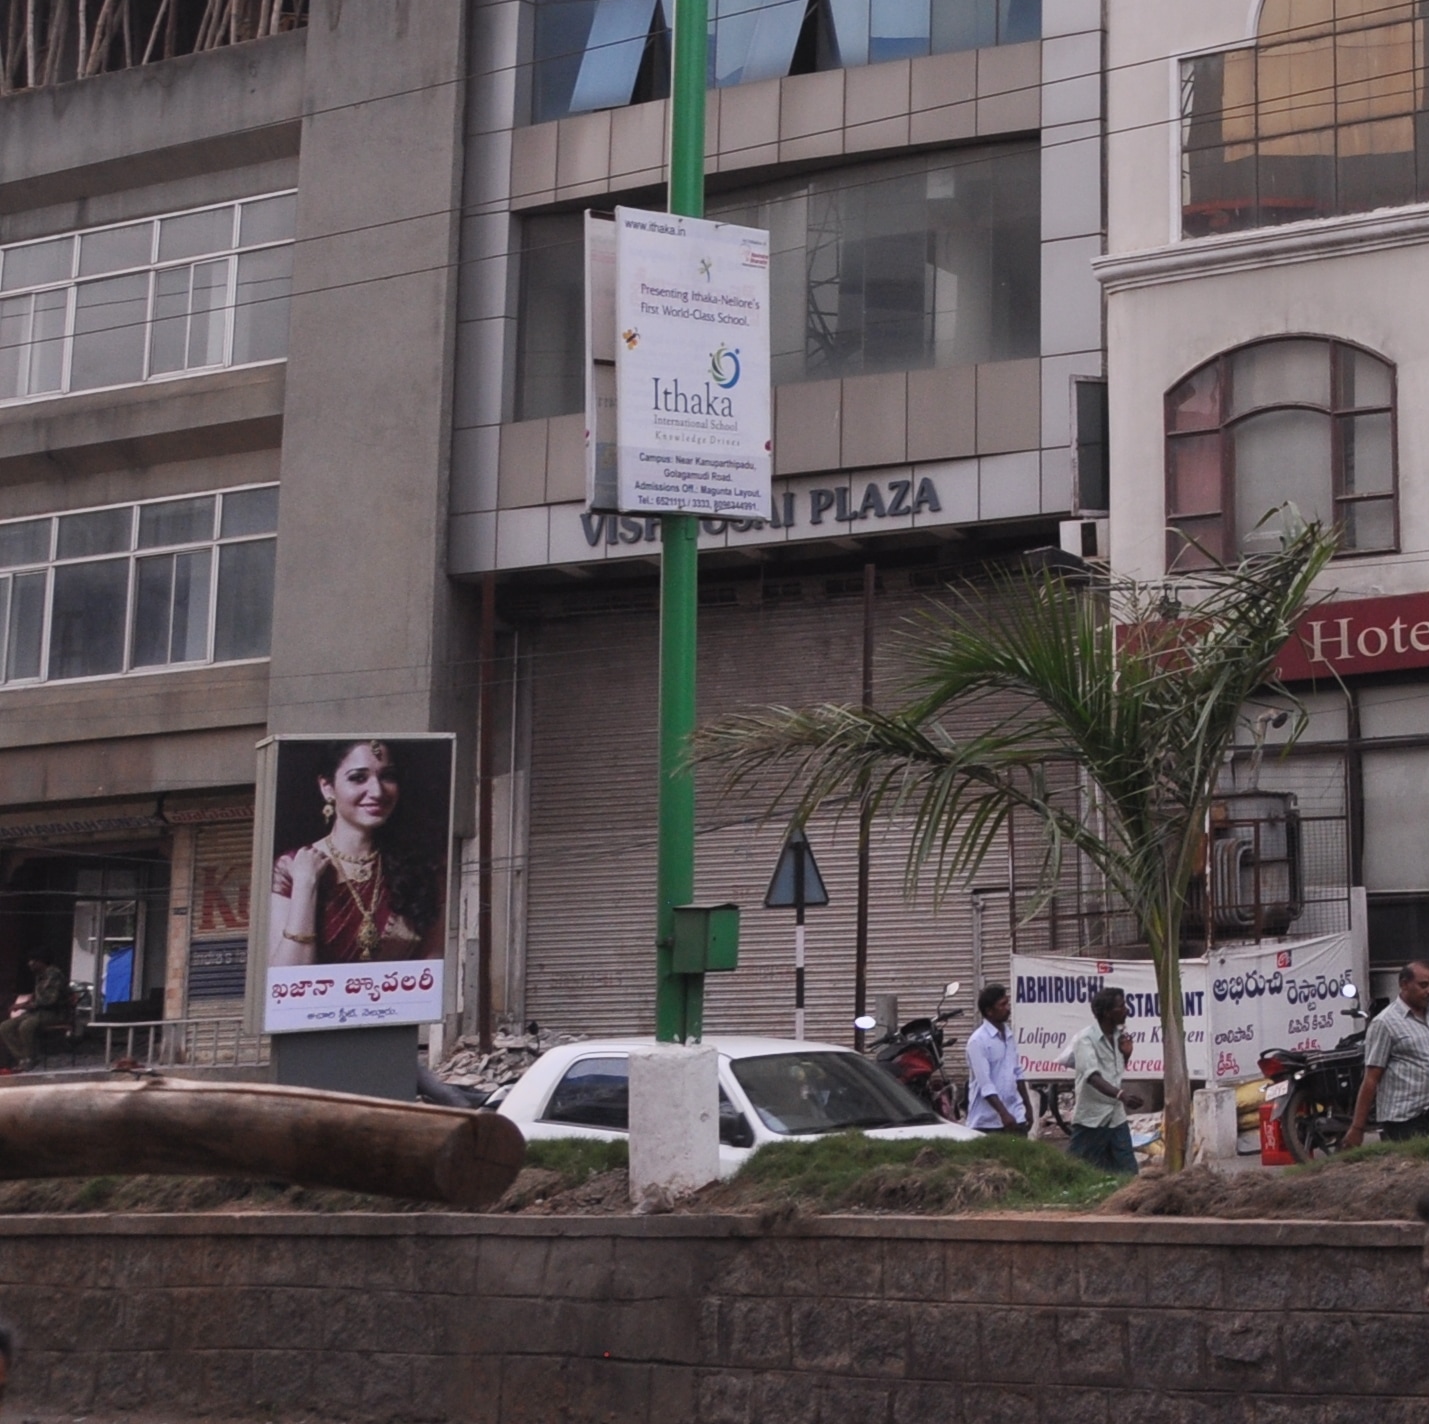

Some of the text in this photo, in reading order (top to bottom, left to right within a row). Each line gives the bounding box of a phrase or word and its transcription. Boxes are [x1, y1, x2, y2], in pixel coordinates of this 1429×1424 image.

[624, 219, 687, 237] www.ithaka.in
[641, 283, 760, 310] Presenting Ithaka-Nellore's
[641, 302, 750, 326] First World-Class School.
[652, 377, 734, 418] Ithaka
[653, 414, 738, 432] International School
[655, 431, 706, 445] Knowledge
[639, 452, 673, 464] Campus:
[675, 456, 693, 465] Near
[664, 468, 733, 482] Golagamudi Road.
[635, 481, 680, 493] Admissions
[700, 486, 732, 497] Magunta
[734, 489, 762, 499] Layout.
[809, 476, 942, 525] PLAZA
[271, 968, 435, 1004] ఖజానా జ్యూవలరీ
[1213, 970, 1283, 1005] అభిరుచి
[1018, 1027, 1066, 1048] Lolipop
[1215, 1024, 1254, 1045] లాలిపాప్
